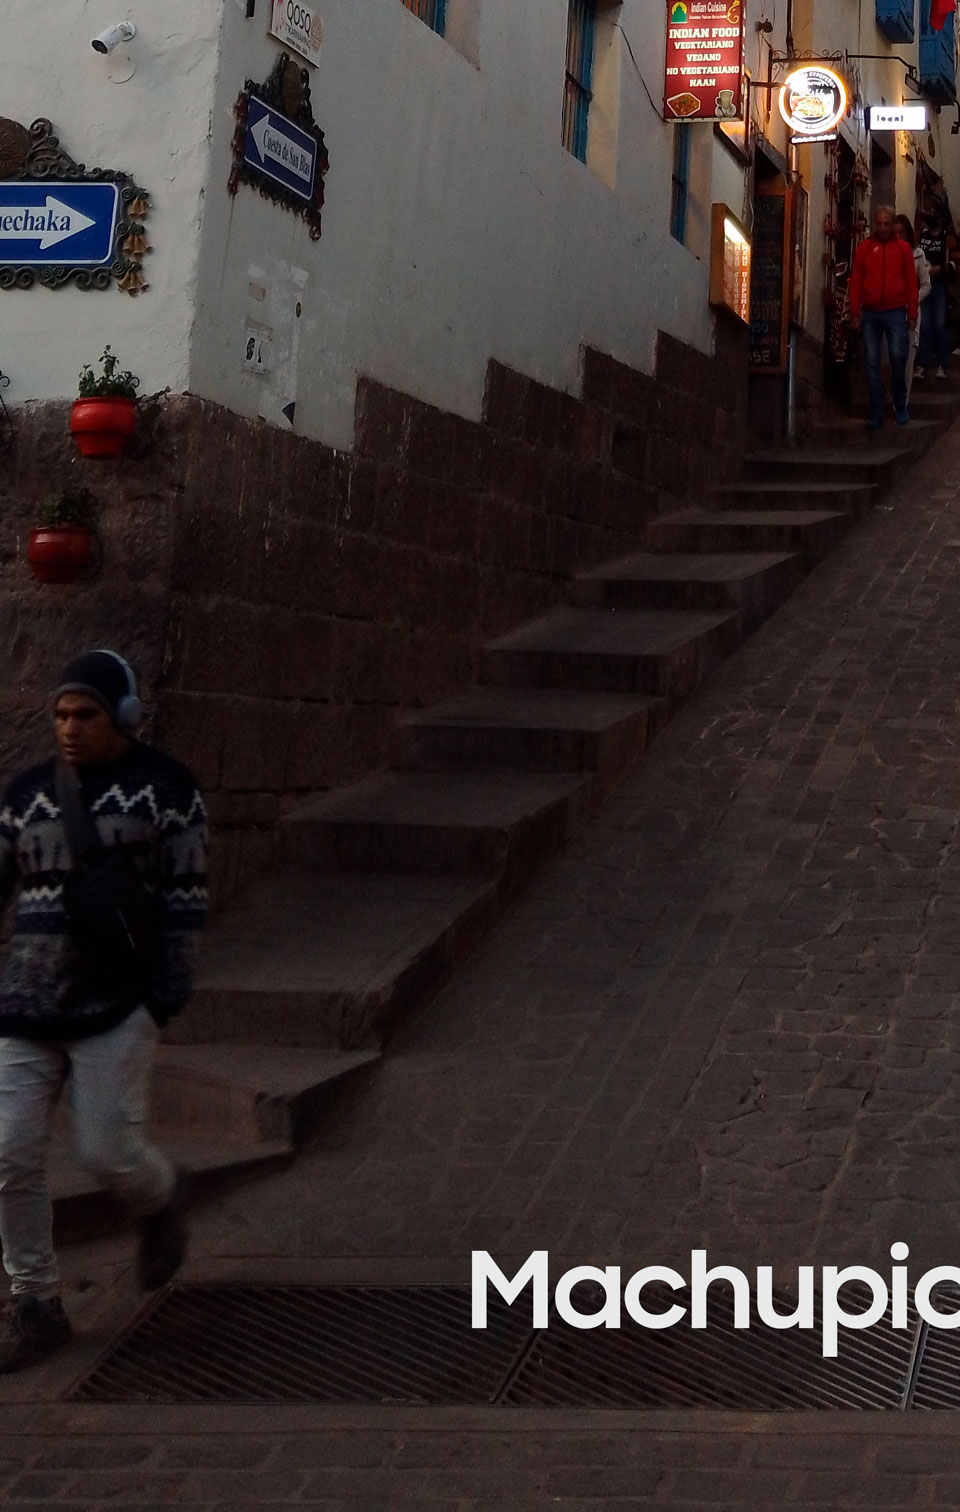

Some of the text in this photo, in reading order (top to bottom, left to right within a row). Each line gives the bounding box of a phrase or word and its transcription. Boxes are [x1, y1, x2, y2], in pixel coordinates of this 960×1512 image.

[691, 1, 727, 13] Indian Cuisine
[286, 0, 312, 38] QOSQ
[669, 27, 740, 39] INDIAN FOOD
[674, 40, 734, 49] VEGETARIANO
[685, 53, 722, 62] VEGANO
[666, 65, 740, 75] NO VEGETARIANO
[689, 78, 716, 87] NAAN
[263, 129, 311, 176] Cuesta de San Blas
